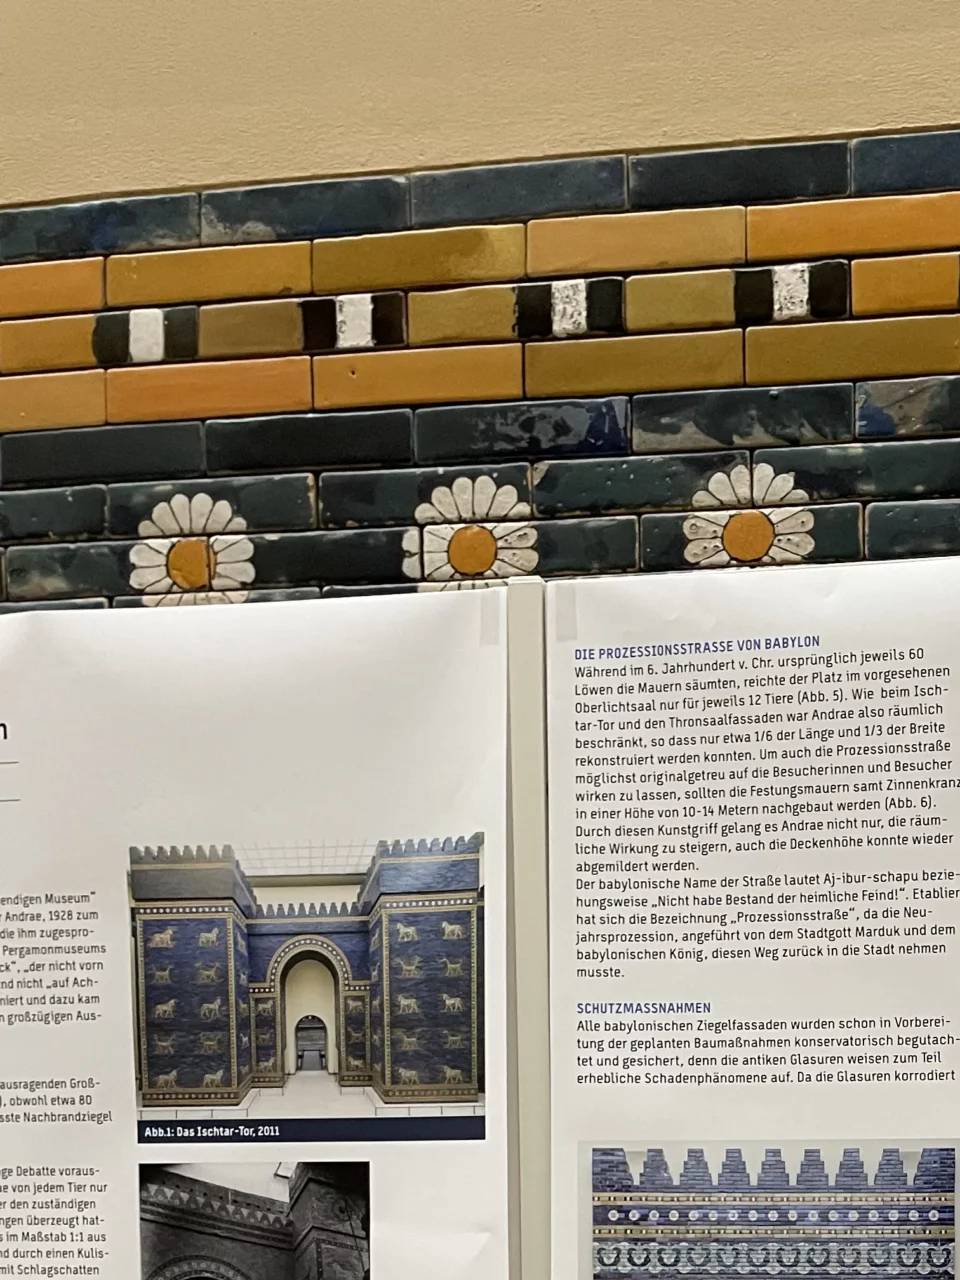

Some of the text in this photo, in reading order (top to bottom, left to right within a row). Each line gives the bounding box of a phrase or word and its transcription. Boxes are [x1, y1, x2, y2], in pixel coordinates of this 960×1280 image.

[574, 635, 820, 661] DIE PROZESSIONSSTRASSE VON BABYLON
[574, 647, 925, 679] Während im 6. Jahrhundert v. Chr. ursprünglich jeweils 60
[575, 868, 960, 894] Der babylonische Name der Straße lautet Aj-ibur-schapu bezie-
[4, 909, 99, 923] Andrae, 1928 zum
[2, 944, 107, 959] Pergamonmuseums
[576, 1001, 711, 1015] SCHUTZMASSNAHMEN
[576, 1015, 951, 1036] Alle babylonischen Ziegelfassaden wurden schon in Vorberei-
[144, 1125, 280, 1137] Abb.1: Das Ischtar-Tor, 2011
[5, 1230, 107, 1243] im Maßstab 1:1 aus
